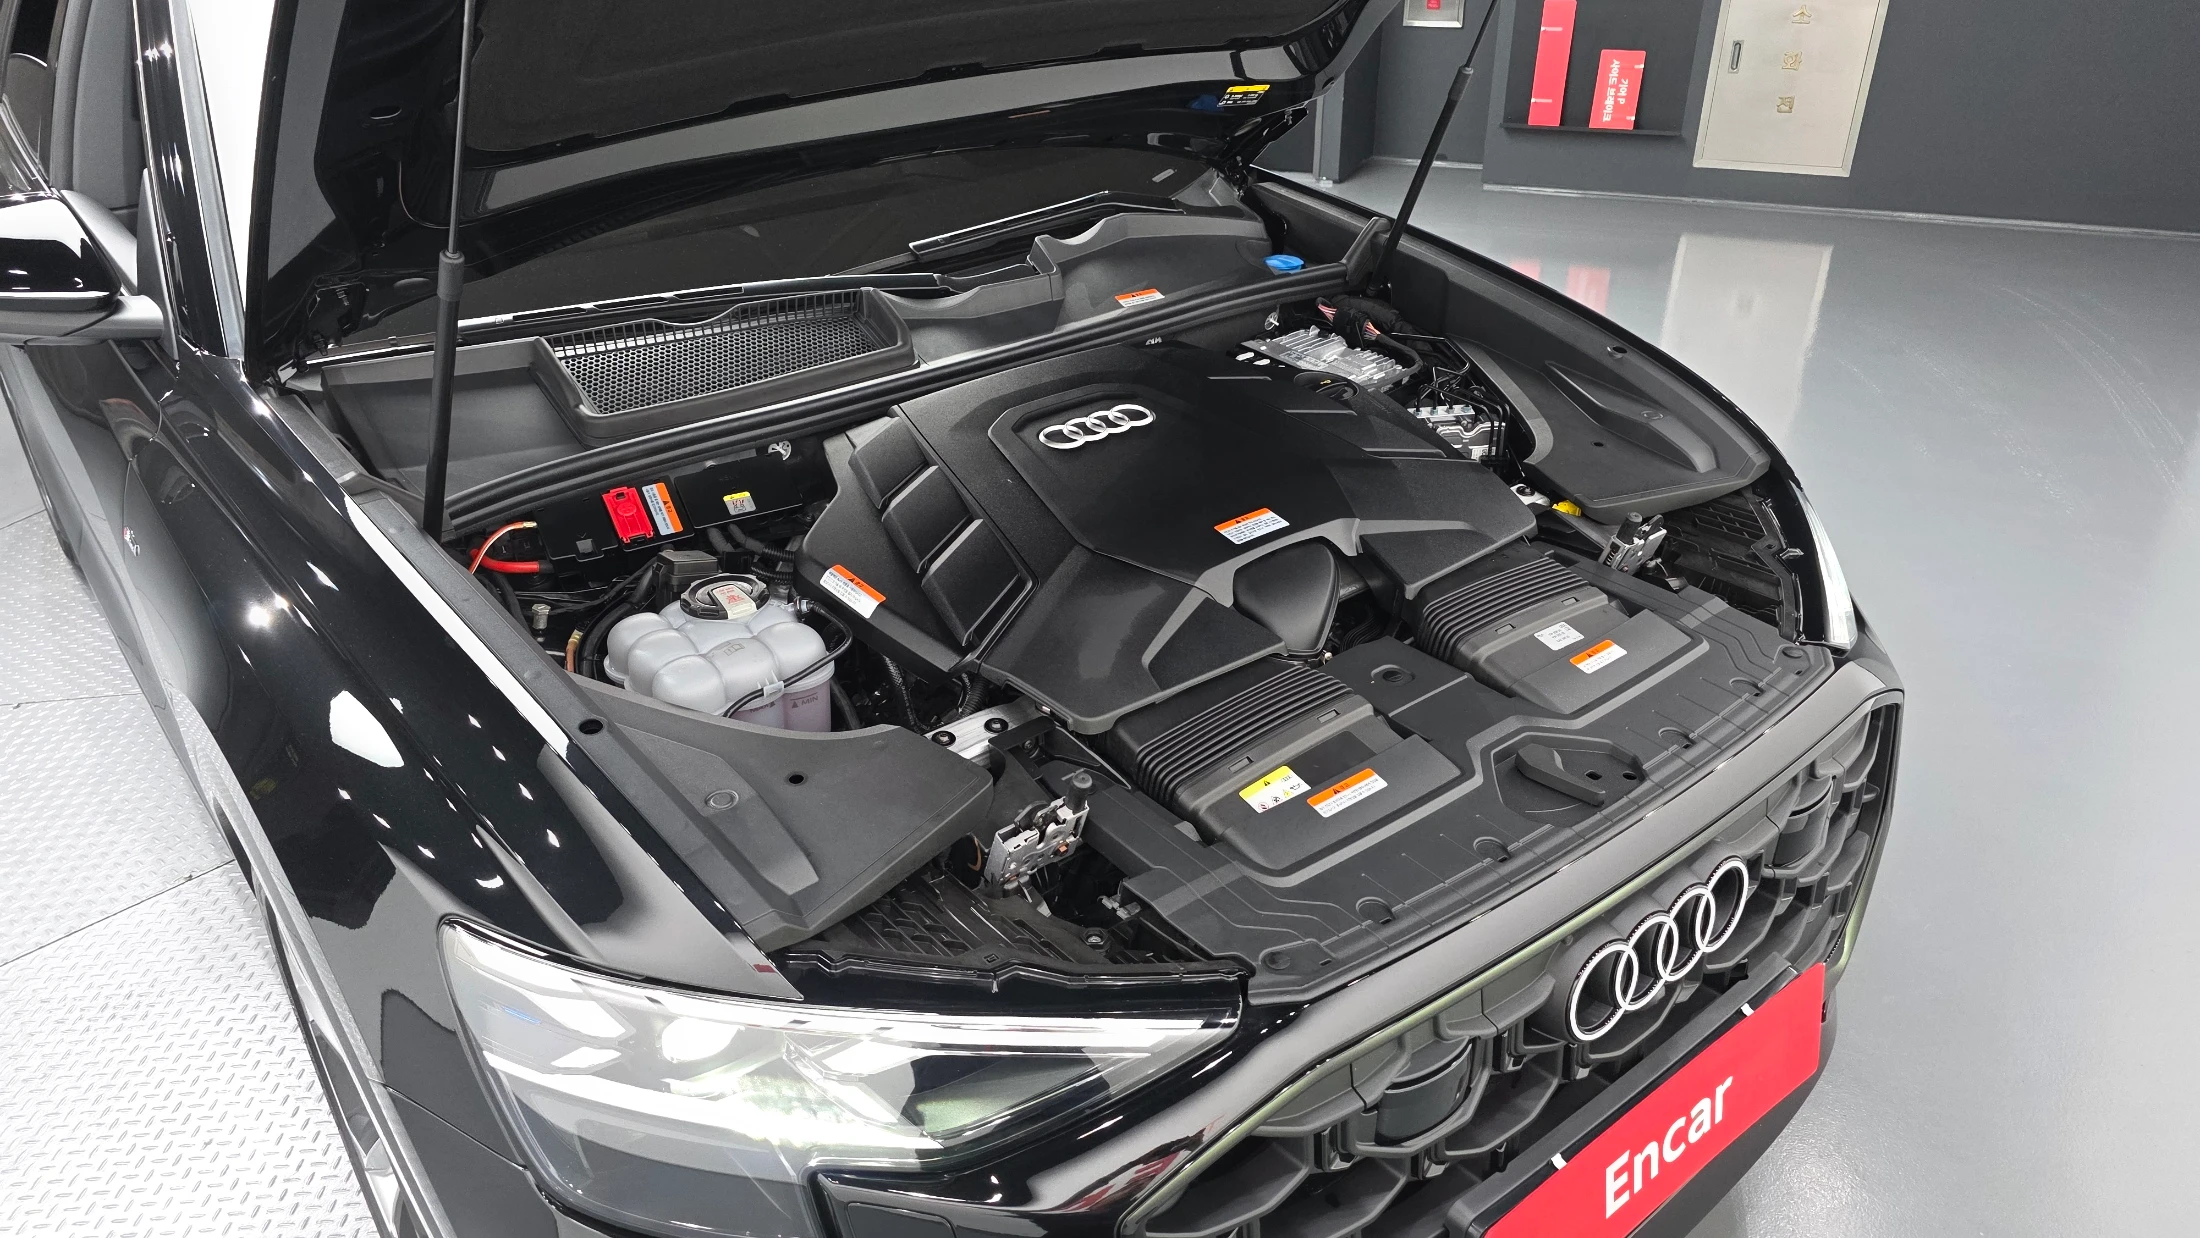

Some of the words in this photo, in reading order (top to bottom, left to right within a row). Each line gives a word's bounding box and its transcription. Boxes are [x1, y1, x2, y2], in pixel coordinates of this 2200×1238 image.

[1608, 59, 1620, 85] 사이드
[1776, 4, 1812, 113] 소화전
[1617, 78, 1629, 96] 기어
[1602, 87, 1616, 122] 브레이크
[801, 696, 819, 706] MIN
[1605, 1075, 1733, 1219] Encar
